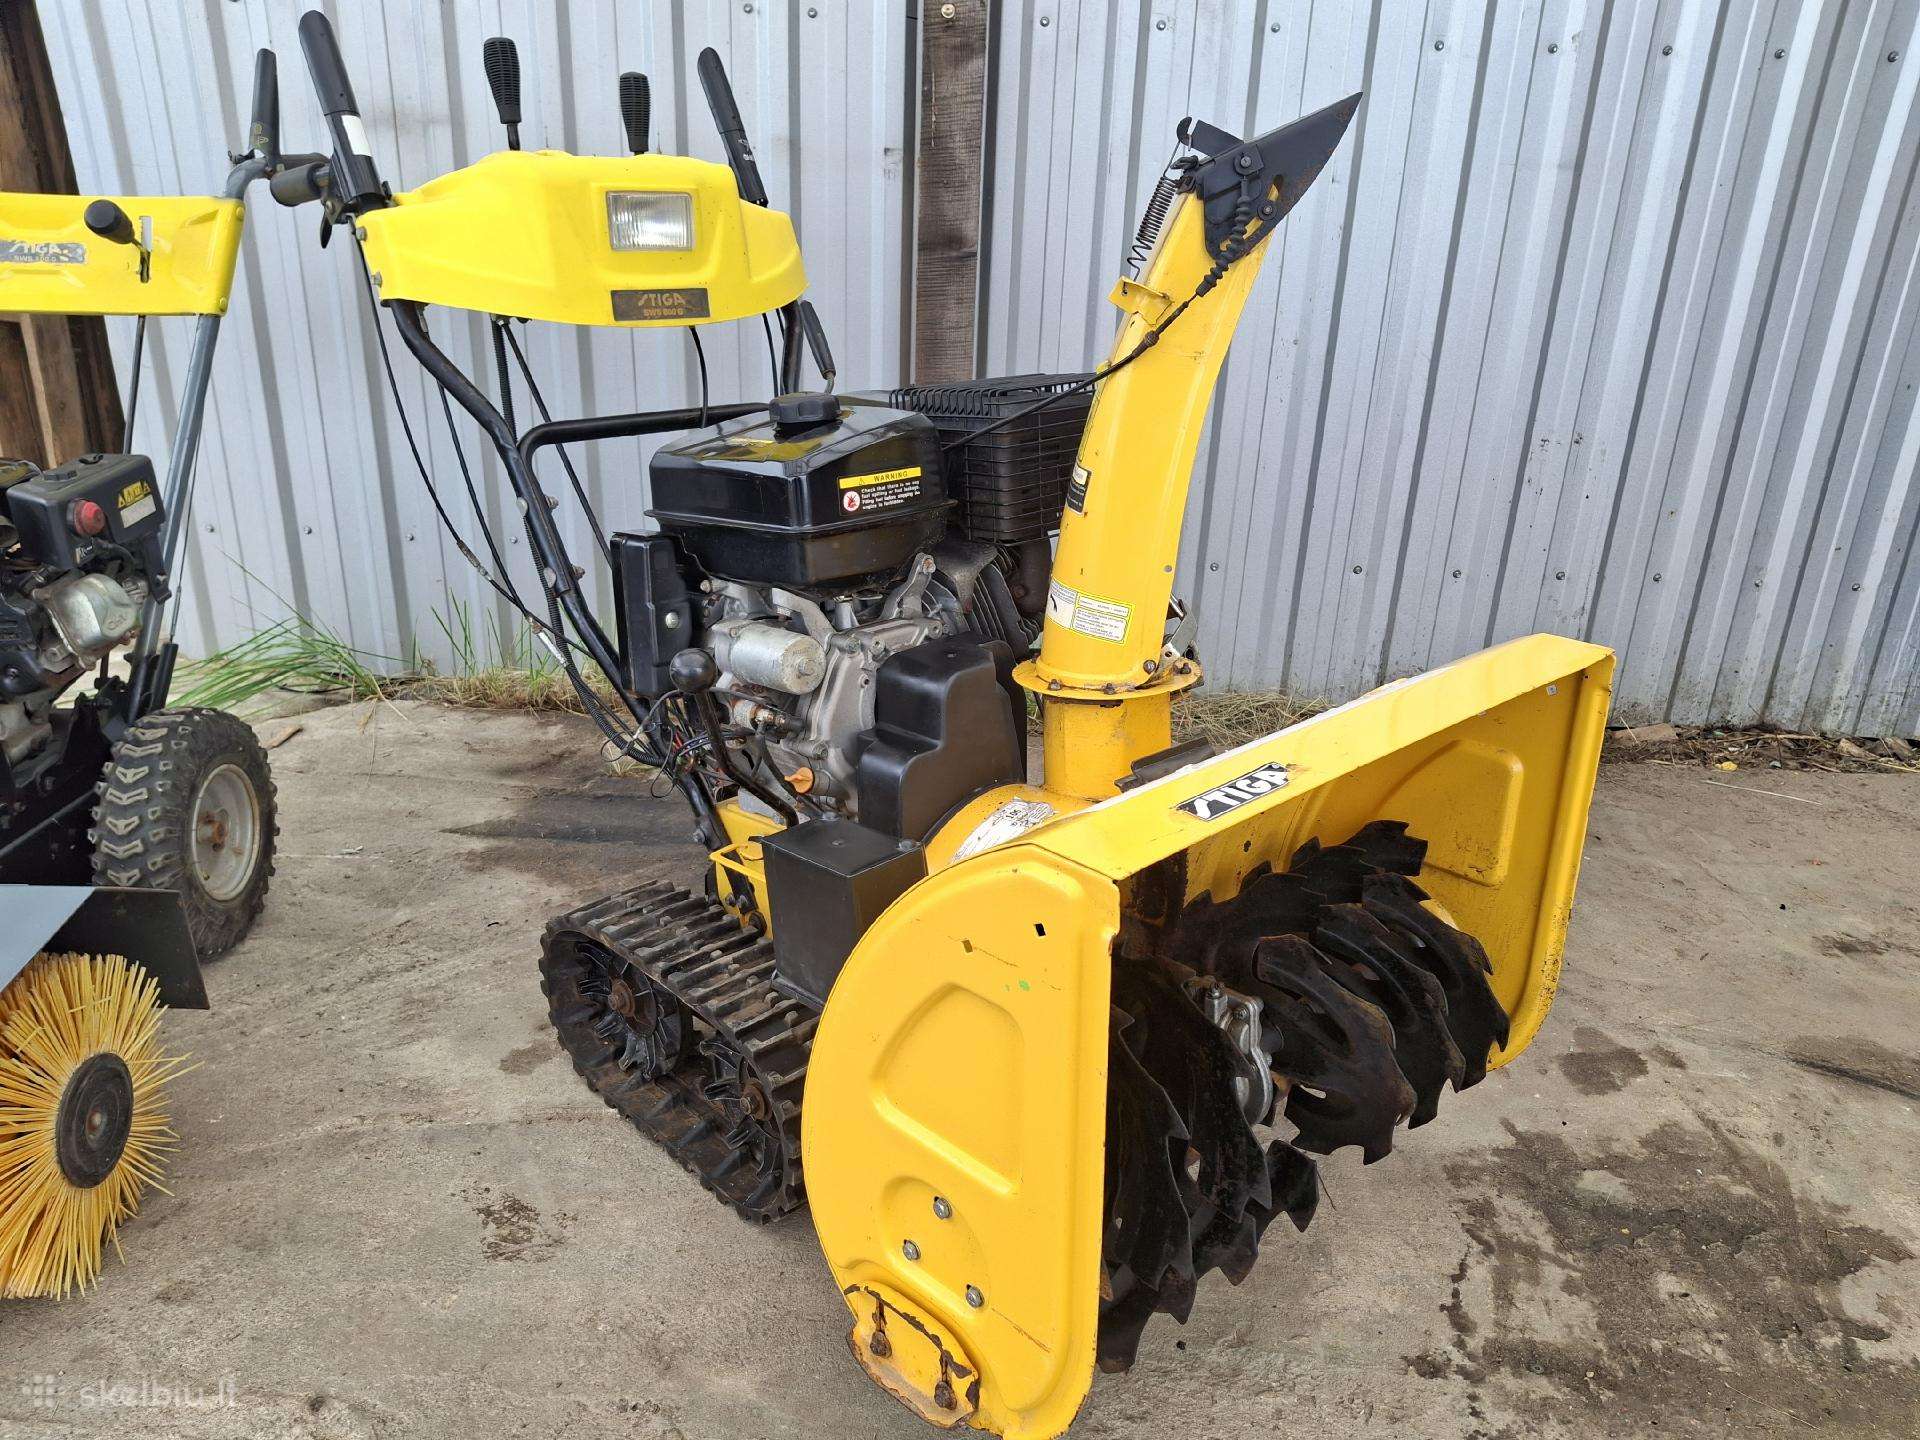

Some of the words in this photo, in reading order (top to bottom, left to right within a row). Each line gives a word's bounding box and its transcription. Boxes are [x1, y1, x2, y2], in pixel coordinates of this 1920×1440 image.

[638, 292, 686, 307] STIGA
[874, 471, 908, 482] WARNING
[1193, 770, 1288, 819] STIGA
